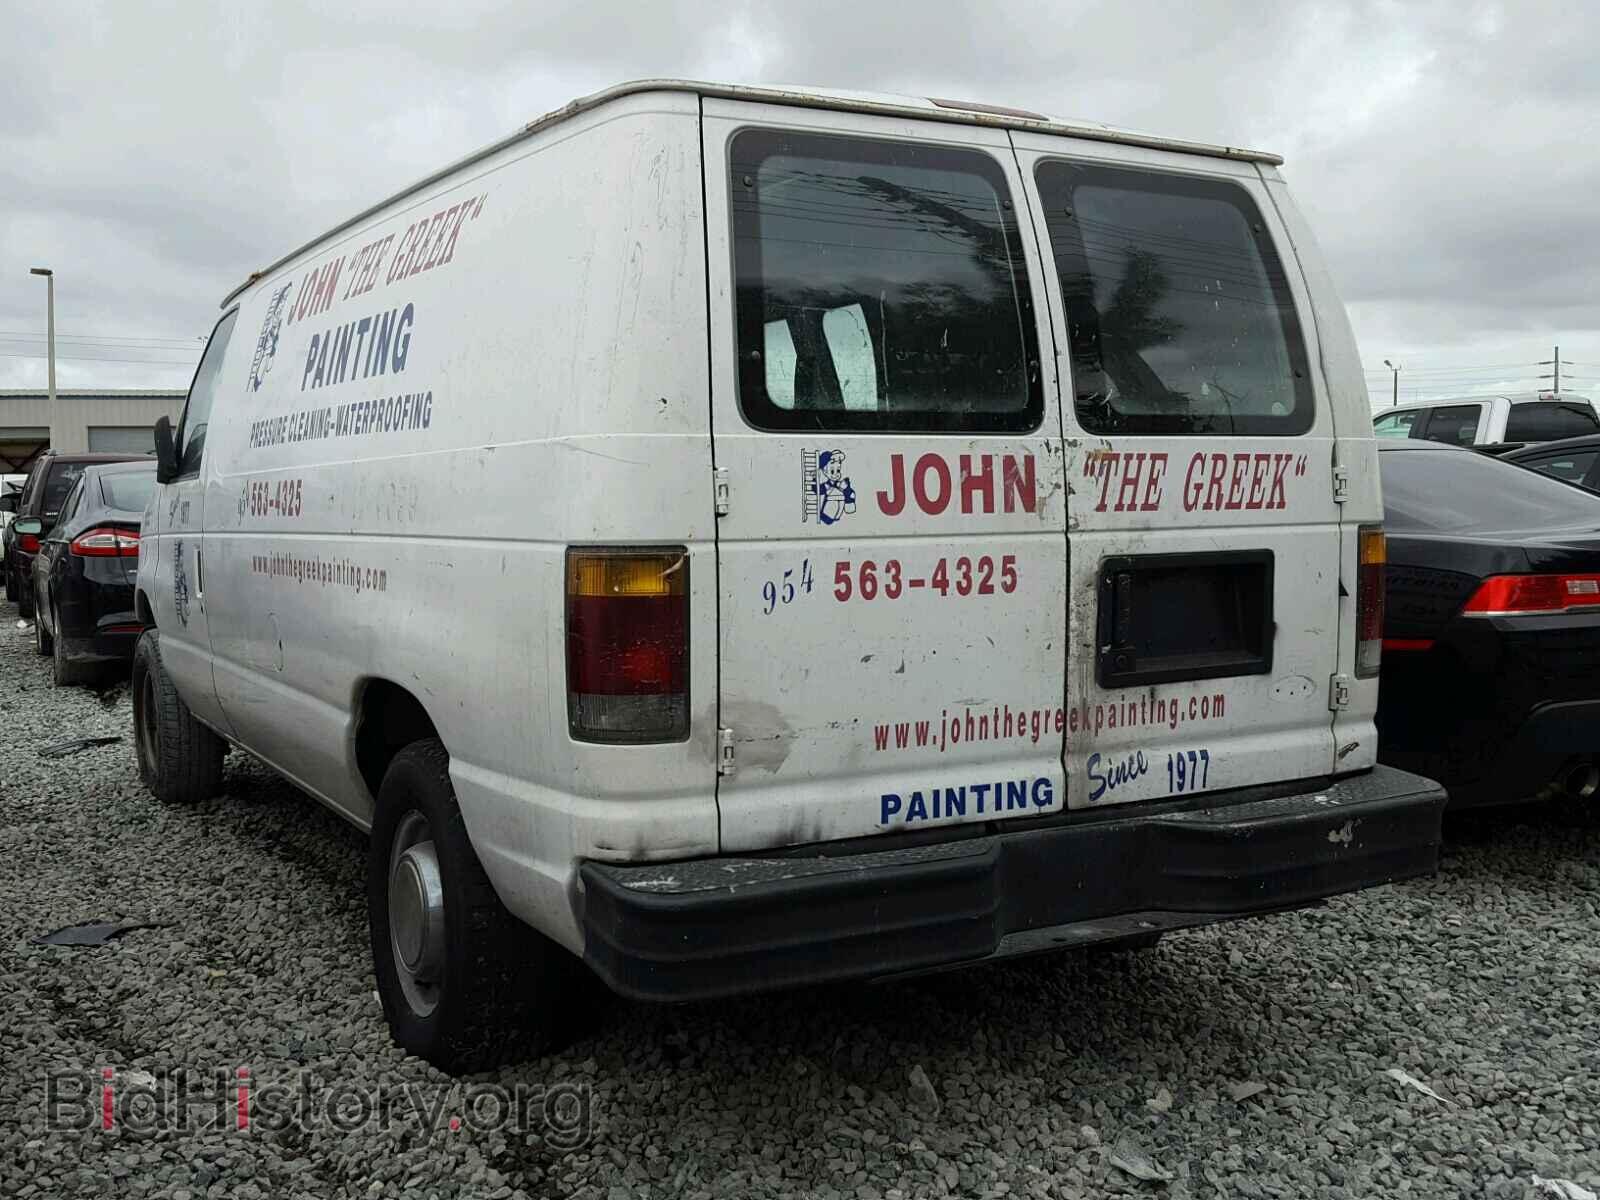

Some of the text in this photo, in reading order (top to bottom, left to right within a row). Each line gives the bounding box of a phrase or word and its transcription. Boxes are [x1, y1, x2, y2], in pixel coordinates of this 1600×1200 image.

[288, 255, 346, 326] JOHN
[301, 302, 414, 391] PAINTING
[249, 415, 288, 448] PRESSURE
[251, 479, 303, 518] 563-4325
[876, 453, 1037, 516] JOHN
[252, 550, 387, 594] www.johnthegreekpainting.com
[763, 555, 1018, 616] 954 563-4325
[874, 692, 1226, 753] www.johnthegreekpainting.com
[880, 777, 1054, 825] PAINTING
[1087, 748, 1211, 801] Since 1977
